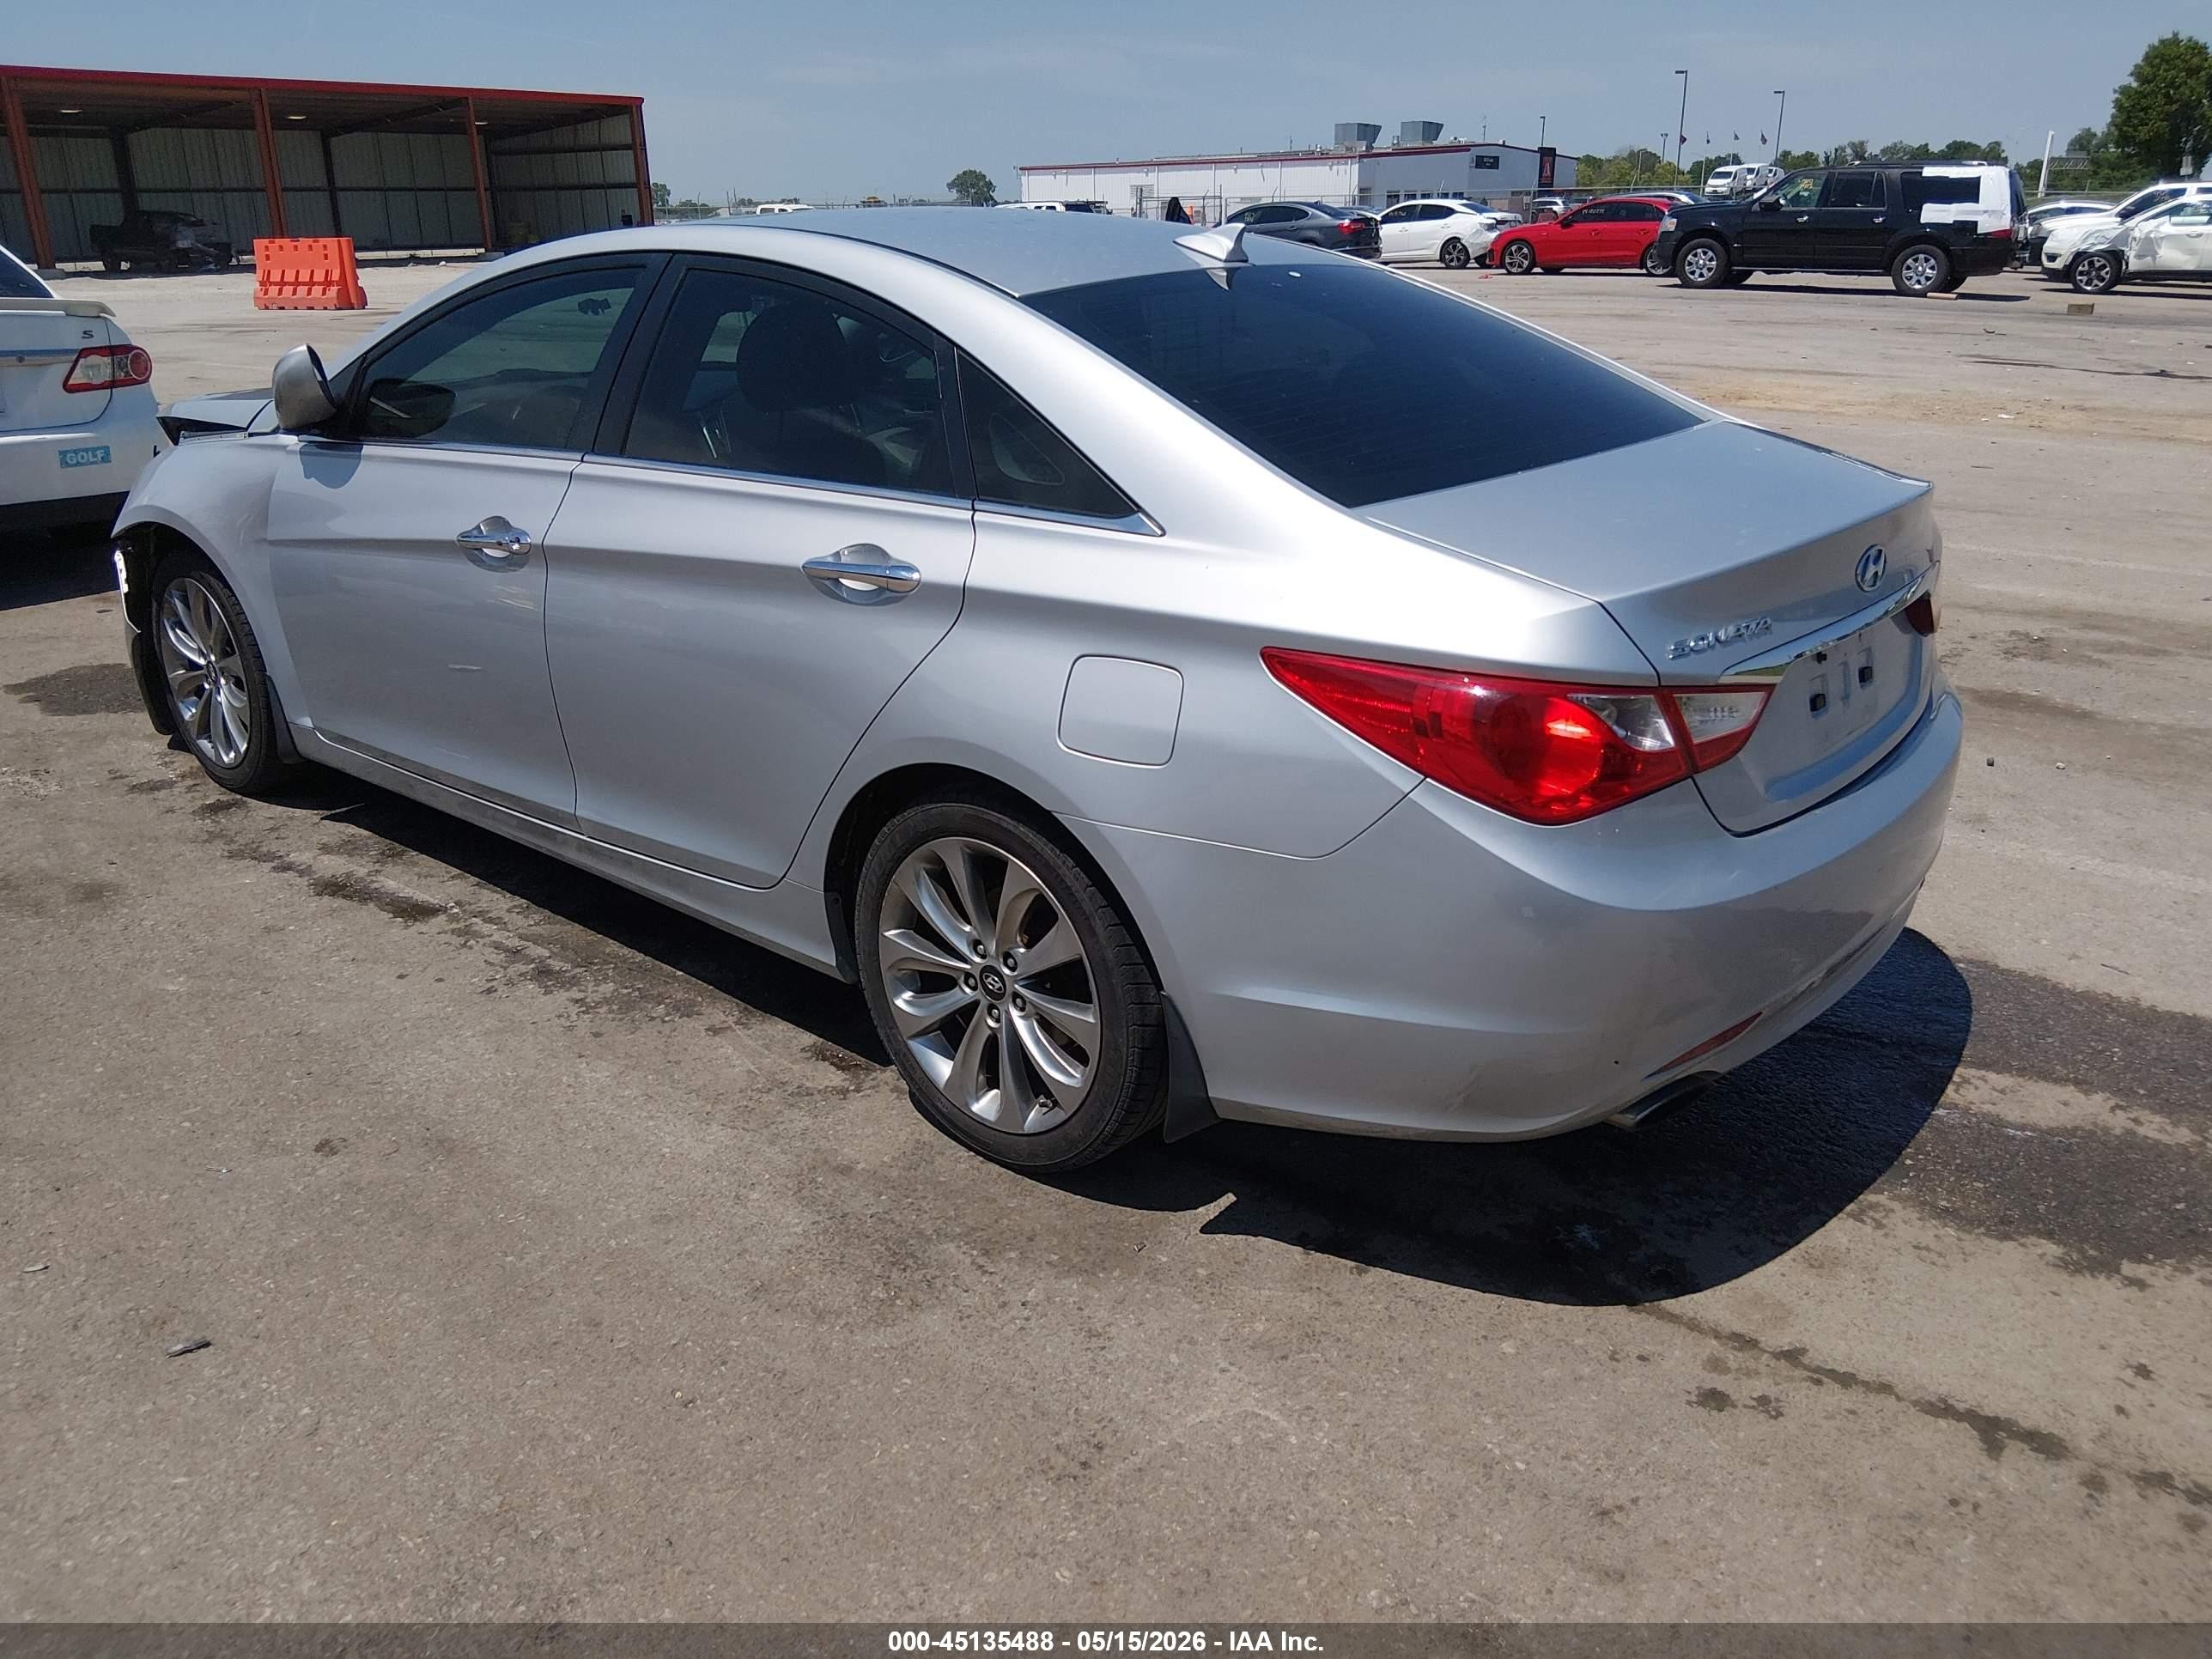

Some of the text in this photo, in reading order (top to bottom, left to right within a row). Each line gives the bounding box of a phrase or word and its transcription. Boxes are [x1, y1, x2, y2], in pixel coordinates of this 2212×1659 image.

[82, 330, 94, 339] S
[66, 449, 106, 465] GOLF
[1668, 617, 1773, 660] SONATA
